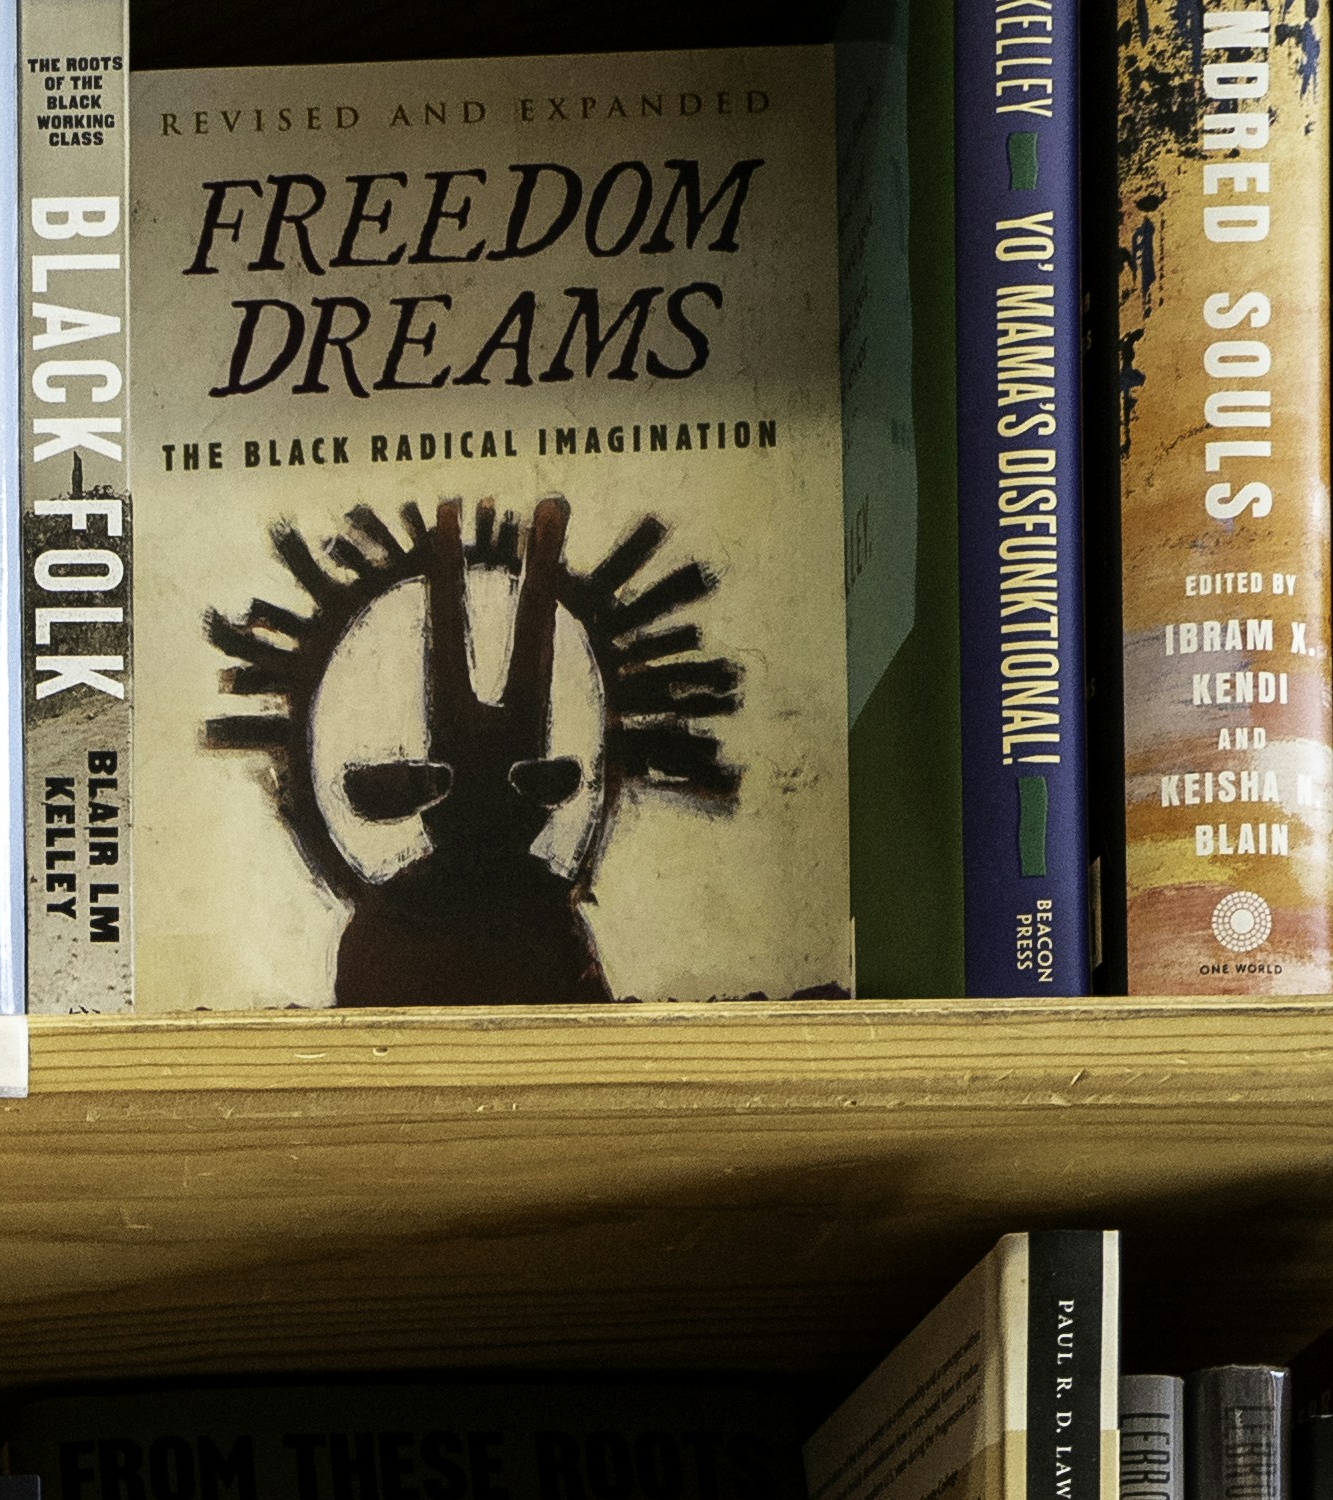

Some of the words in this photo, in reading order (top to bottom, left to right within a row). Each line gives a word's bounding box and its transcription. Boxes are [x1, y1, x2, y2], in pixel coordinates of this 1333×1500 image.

[185, 157, 765, 275] FREEDOM
[996, 211, 1054, 271] YO'
[32, 196, 122, 461] BLACK
[211, 283, 724, 398] DREAMS
[997, 285, 1056, 437] MAMA'S
[33, 500, 126, 703] FOLK
[999, 449, 1060, 764] DISFUNKTIONAL!
